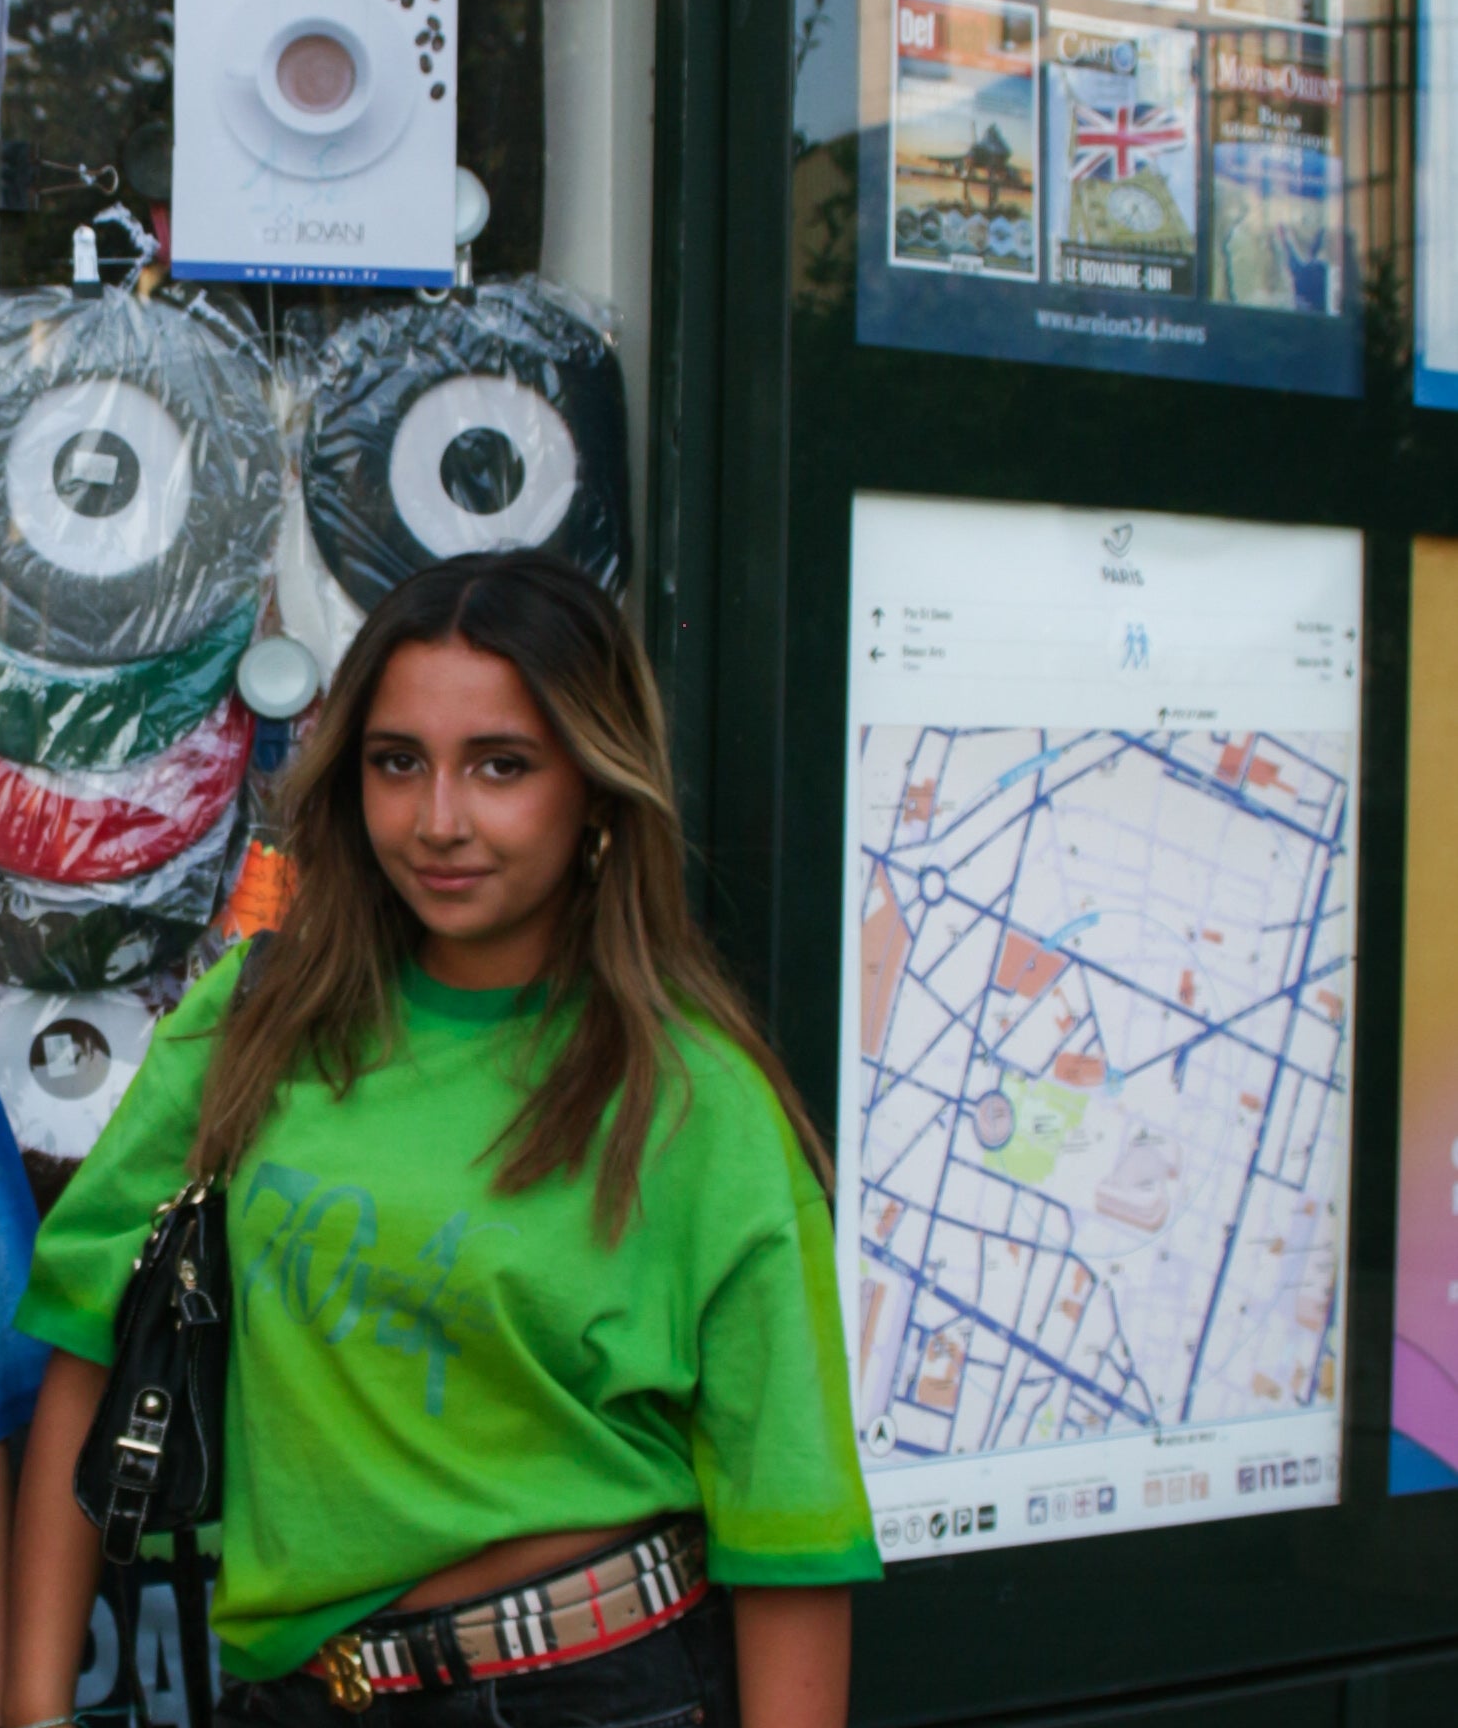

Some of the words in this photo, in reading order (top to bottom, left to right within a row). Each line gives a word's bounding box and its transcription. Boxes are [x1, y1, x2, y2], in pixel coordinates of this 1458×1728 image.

[294, 219, 366, 244] JIOVANI
[243, 265, 380, 283] www.jiovani.fr
[1102, 564, 1145, 587] PARIS
